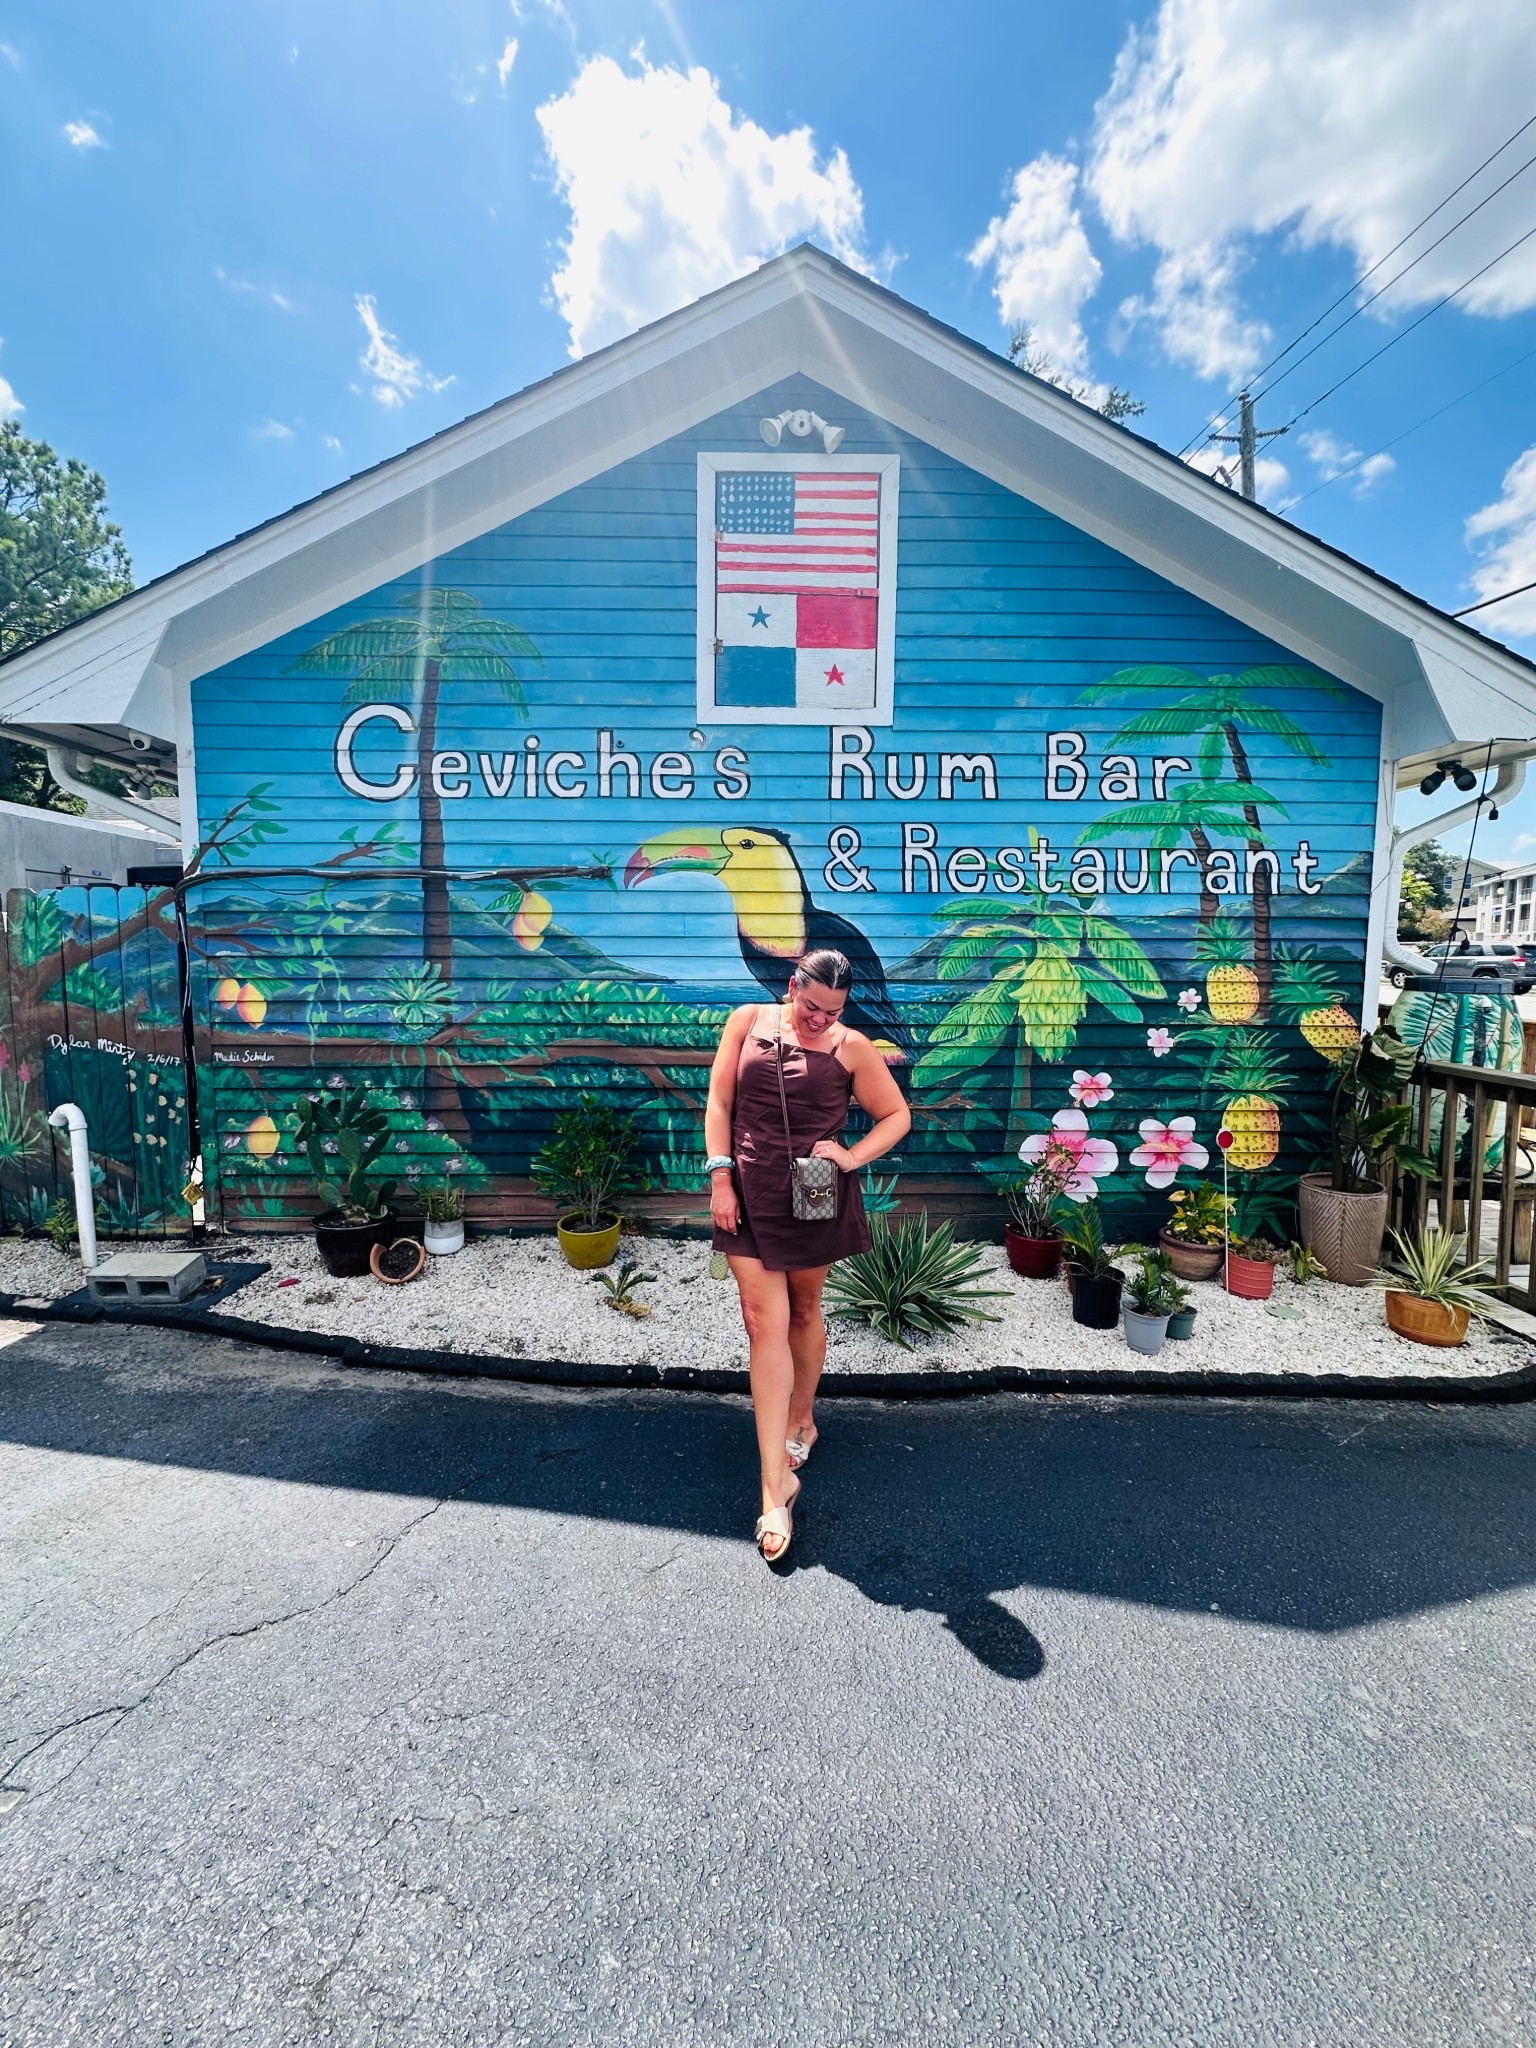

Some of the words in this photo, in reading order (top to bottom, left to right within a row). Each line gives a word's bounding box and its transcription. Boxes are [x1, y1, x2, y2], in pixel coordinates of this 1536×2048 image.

[334, 703, 751, 800] Ceviche's
[828, 725, 999, 800] Rum
[1045, 731, 1192, 800] Bar
[823, 825, 876, 893] &
[901, 822, 1323, 895] Restaurant
[47, 1034, 91, 1055] Dylan
[147, 1053, 182, 1067] 2/6/17
